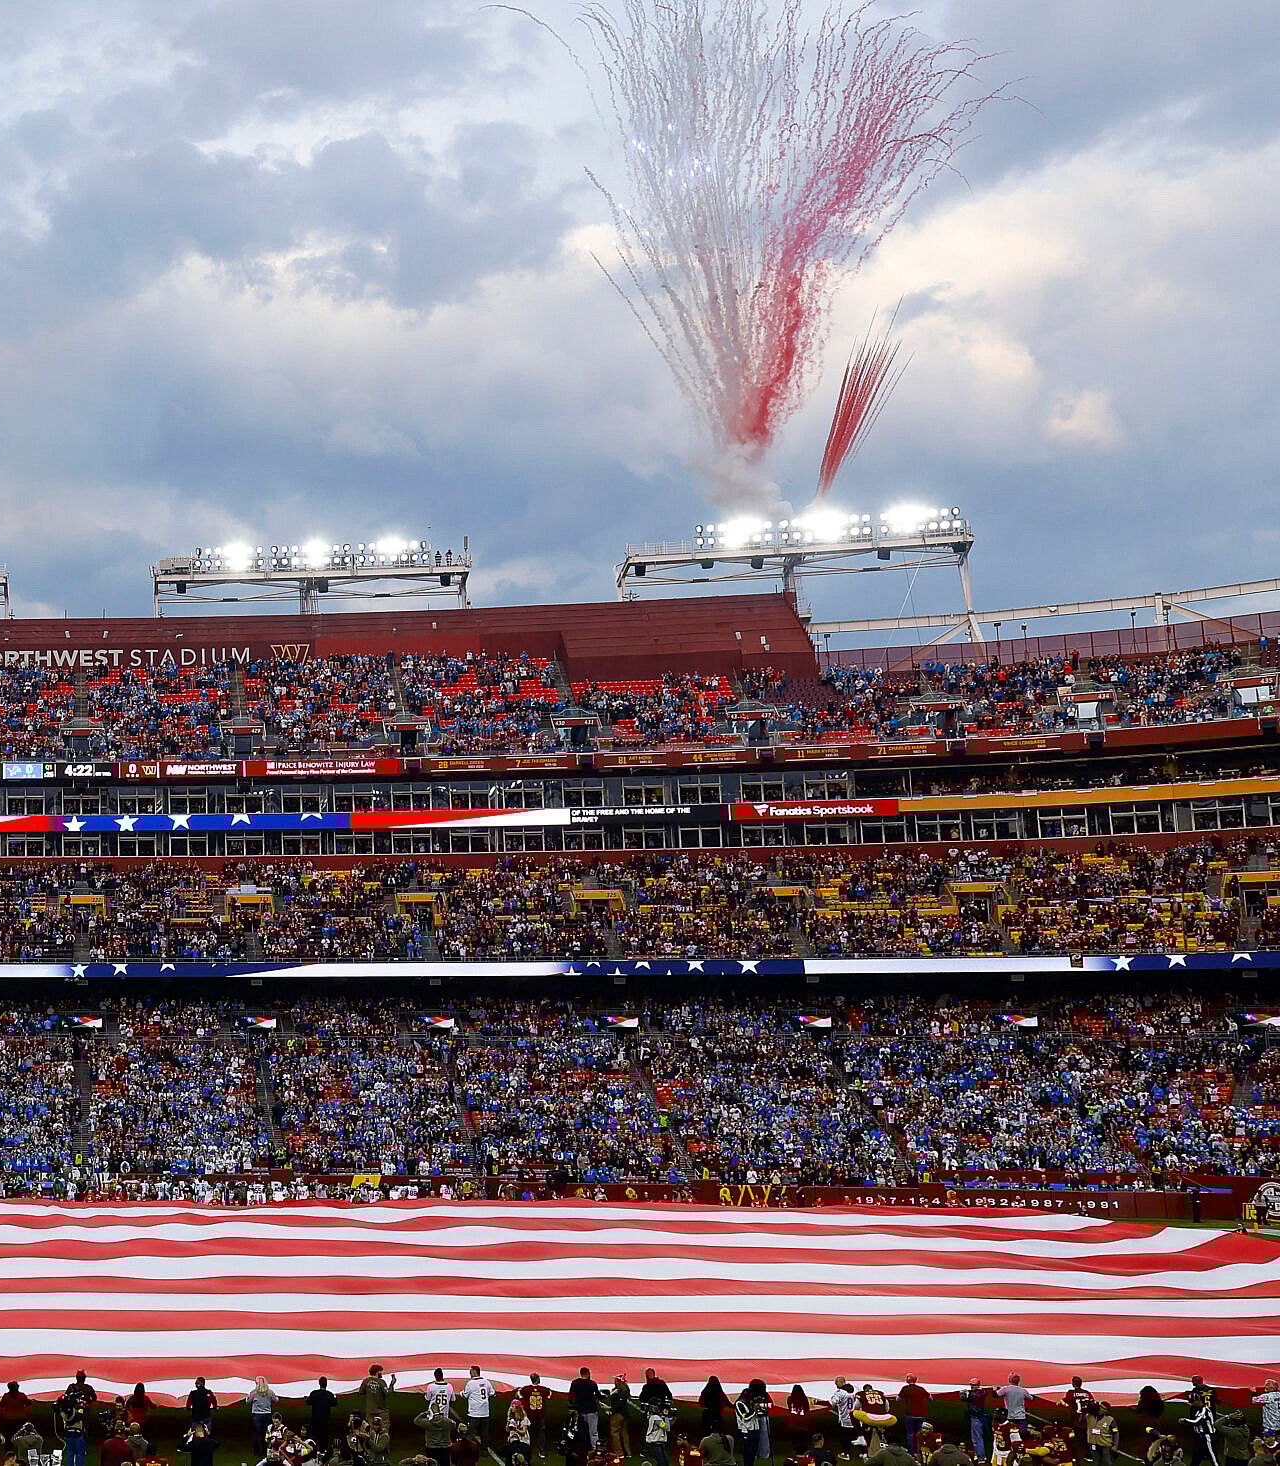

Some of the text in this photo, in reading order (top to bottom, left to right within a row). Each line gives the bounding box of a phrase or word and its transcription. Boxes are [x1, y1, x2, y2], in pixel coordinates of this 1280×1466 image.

[130, 647, 251, 667] STADIUM
[25, 765, 34, 774] 0
[128, 763, 138, 774] 0
[188, 763, 238, 771] NORTHWEST
[277, 760, 376, 769] PRICE BENOWITZ INJURY LAW
[63, 764, 94, 777] 4:22
[571, 809, 581, 817] OF
[582, 809, 595, 817] THE
[596, 808, 614, 816] FREE
[615, 808, 630, 816] AND
[645, 807, 665, 815] HOME
[666, 807, 676, 815] OF
[677, 806, 692, 814] THE
[769, 803, 874, 818] Fanatics Sportsbook
[571, 815, 599, 824] BRAVE?
[856, 1196, 896, 1205] 197
[1077, 1200, 1119, 1209] 1991
[480, 1387, 488, 1400] 9
[434, 1394, 449, 1406] 66
